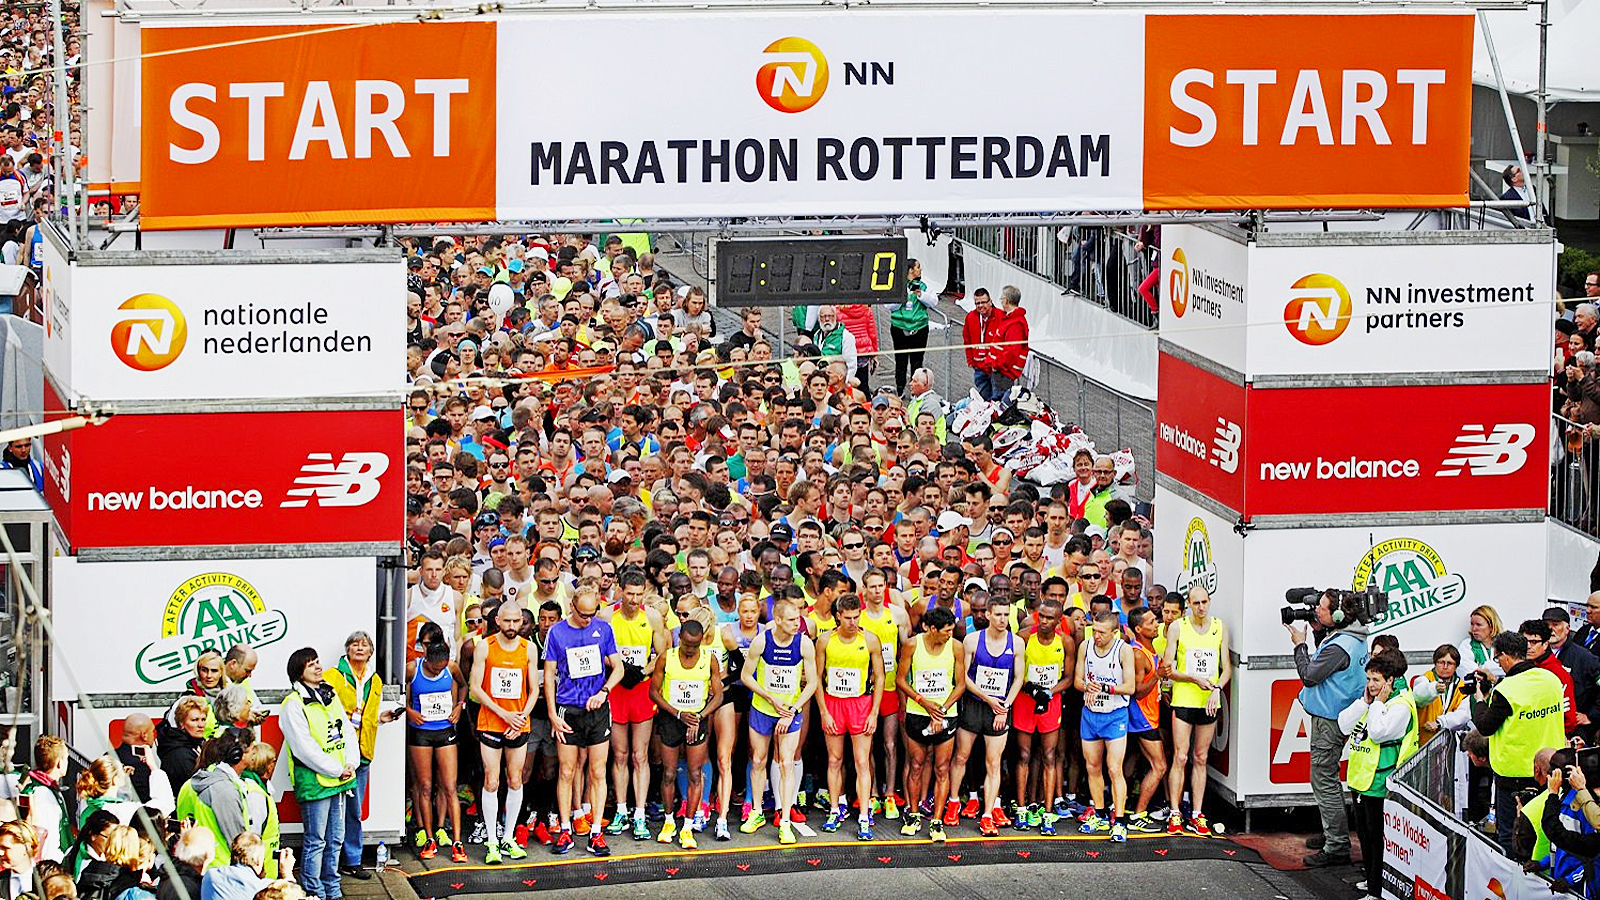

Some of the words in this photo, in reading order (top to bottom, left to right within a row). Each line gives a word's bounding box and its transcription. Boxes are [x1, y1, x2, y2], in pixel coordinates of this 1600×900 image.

[843, 61, 894, 86] NN
[1169, 68, 1446, 147] START
[169, 78, 469, 164] START
[531, 138, 798, 185] MARATHON
[817, 134, 1111, 182] ROTTERDAM
[1192, 267, 1203, 288] NN
[1203, 269, 1244, 304] investment
[1365, 287, 1401, 304] NN
[1407, 282, 1535, 304] investment
[204, 301, 328, 326] nationale
[1191, 293, 1222, 320] partners
[1366, 308, 1464, 334] partners
[204, 329, 371, 354] nederlanden
[1160, 421, 1175, 445] new
[1175, 424, 1206, 460] balance
[1260, 462, 1312, 481] new
[1315, 456, 1420, 480] balance
[88, 491, 144, 511] new
[149, 485, 263, 510] balance
[1191, 541, 1207, 577] AA
[1377, 540, 1418, 556] ACTIVITY
[1420, 545, 1440, 566] DRINK
[1382, 559, 1431, 596] AA
[166, 588, 188, 624] AFTER
[189, 574, 233, 592] ACTIVITY
[235, 579, 258, 601] DRINK
[192, 594, 249, 640] AA
[579, 657, 590, 666] 59
[624, 656, 635, 666] 23
[1196, 659, 1208, 668] 56
[501, 680, 512, 688] 58
[840, 678, 849, 687] 11
[926, 680, 937, 688] 22
[986, 678, 997, 686] 27
[1039, 673, 1050, 683] 25
[682, 691, 692, 699] 16
